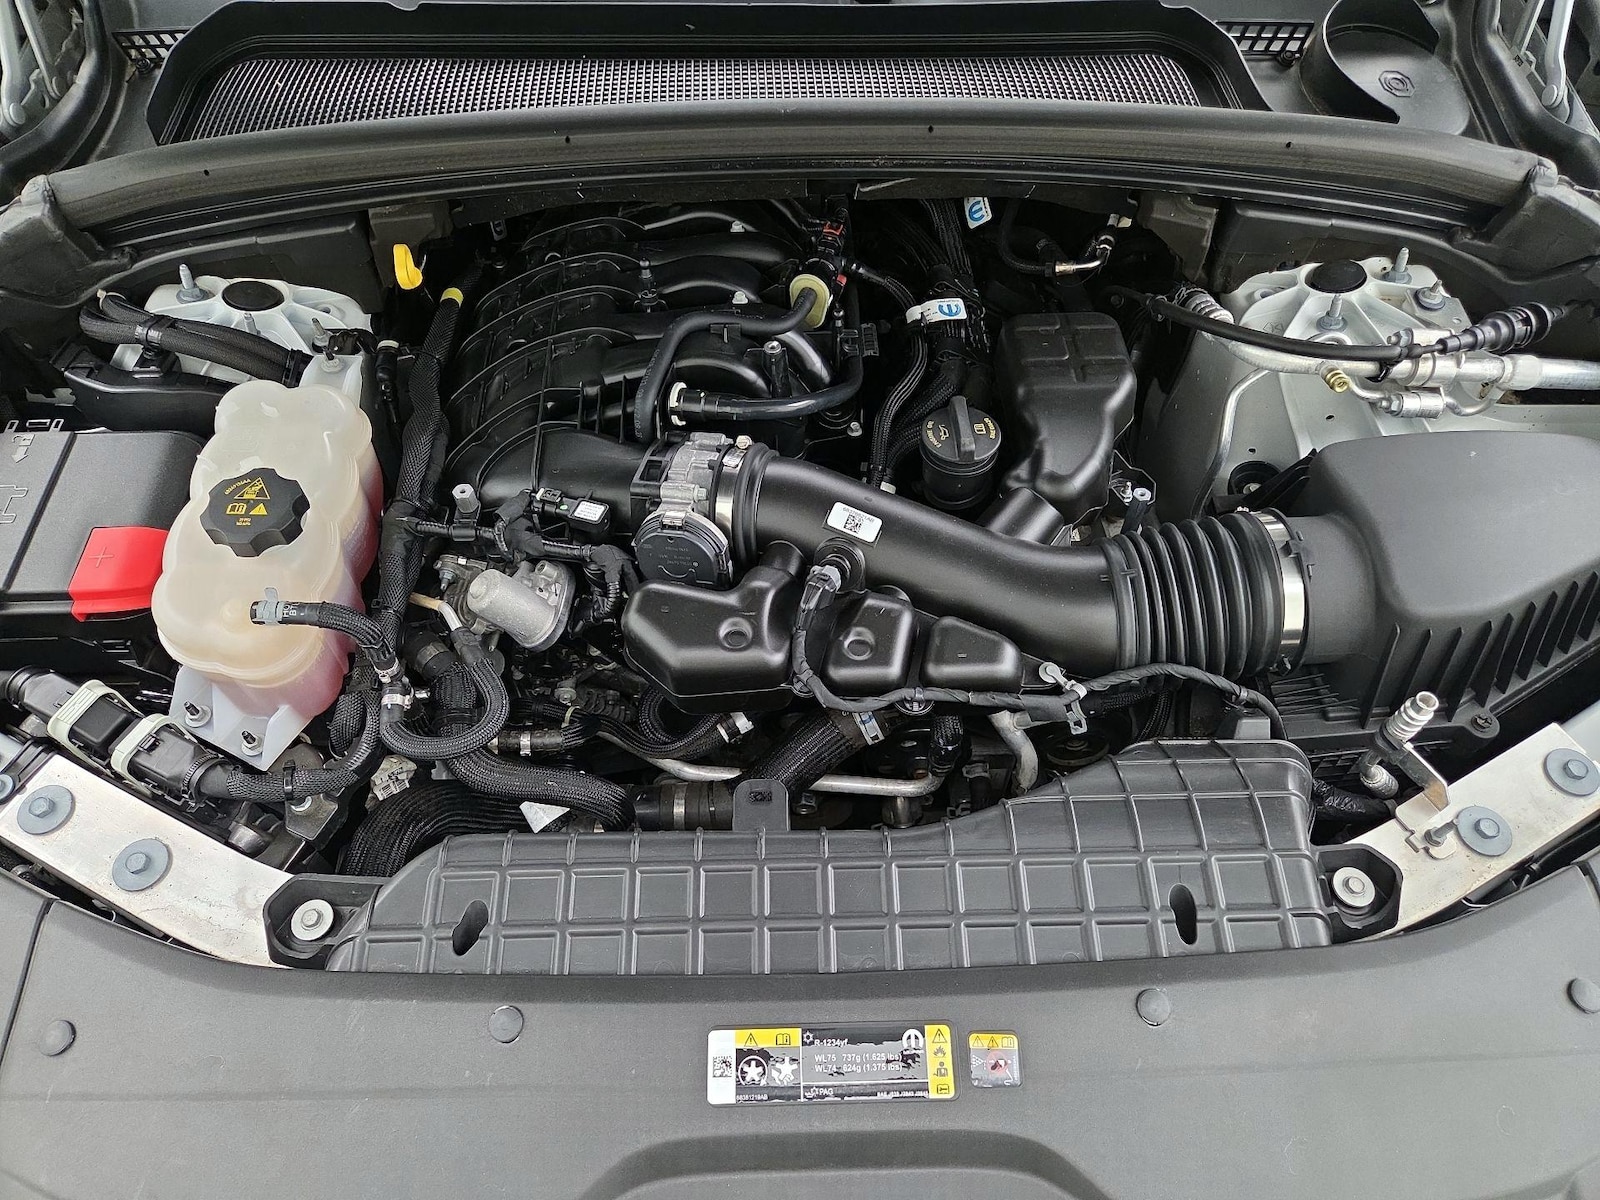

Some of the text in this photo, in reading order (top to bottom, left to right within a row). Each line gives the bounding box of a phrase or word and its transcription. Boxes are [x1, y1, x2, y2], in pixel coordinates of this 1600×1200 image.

[926, 429, 942, 448] ENGINE
[814, 1038, 849, 1047] R-1234yf
[814, 1053, 902, 1063] WL75 737g (1.625 lbs)
[814, 1063, 903, 1073] WL74 624g (1.375 lbs)
[819, 1088, 834, 1096] PAG
